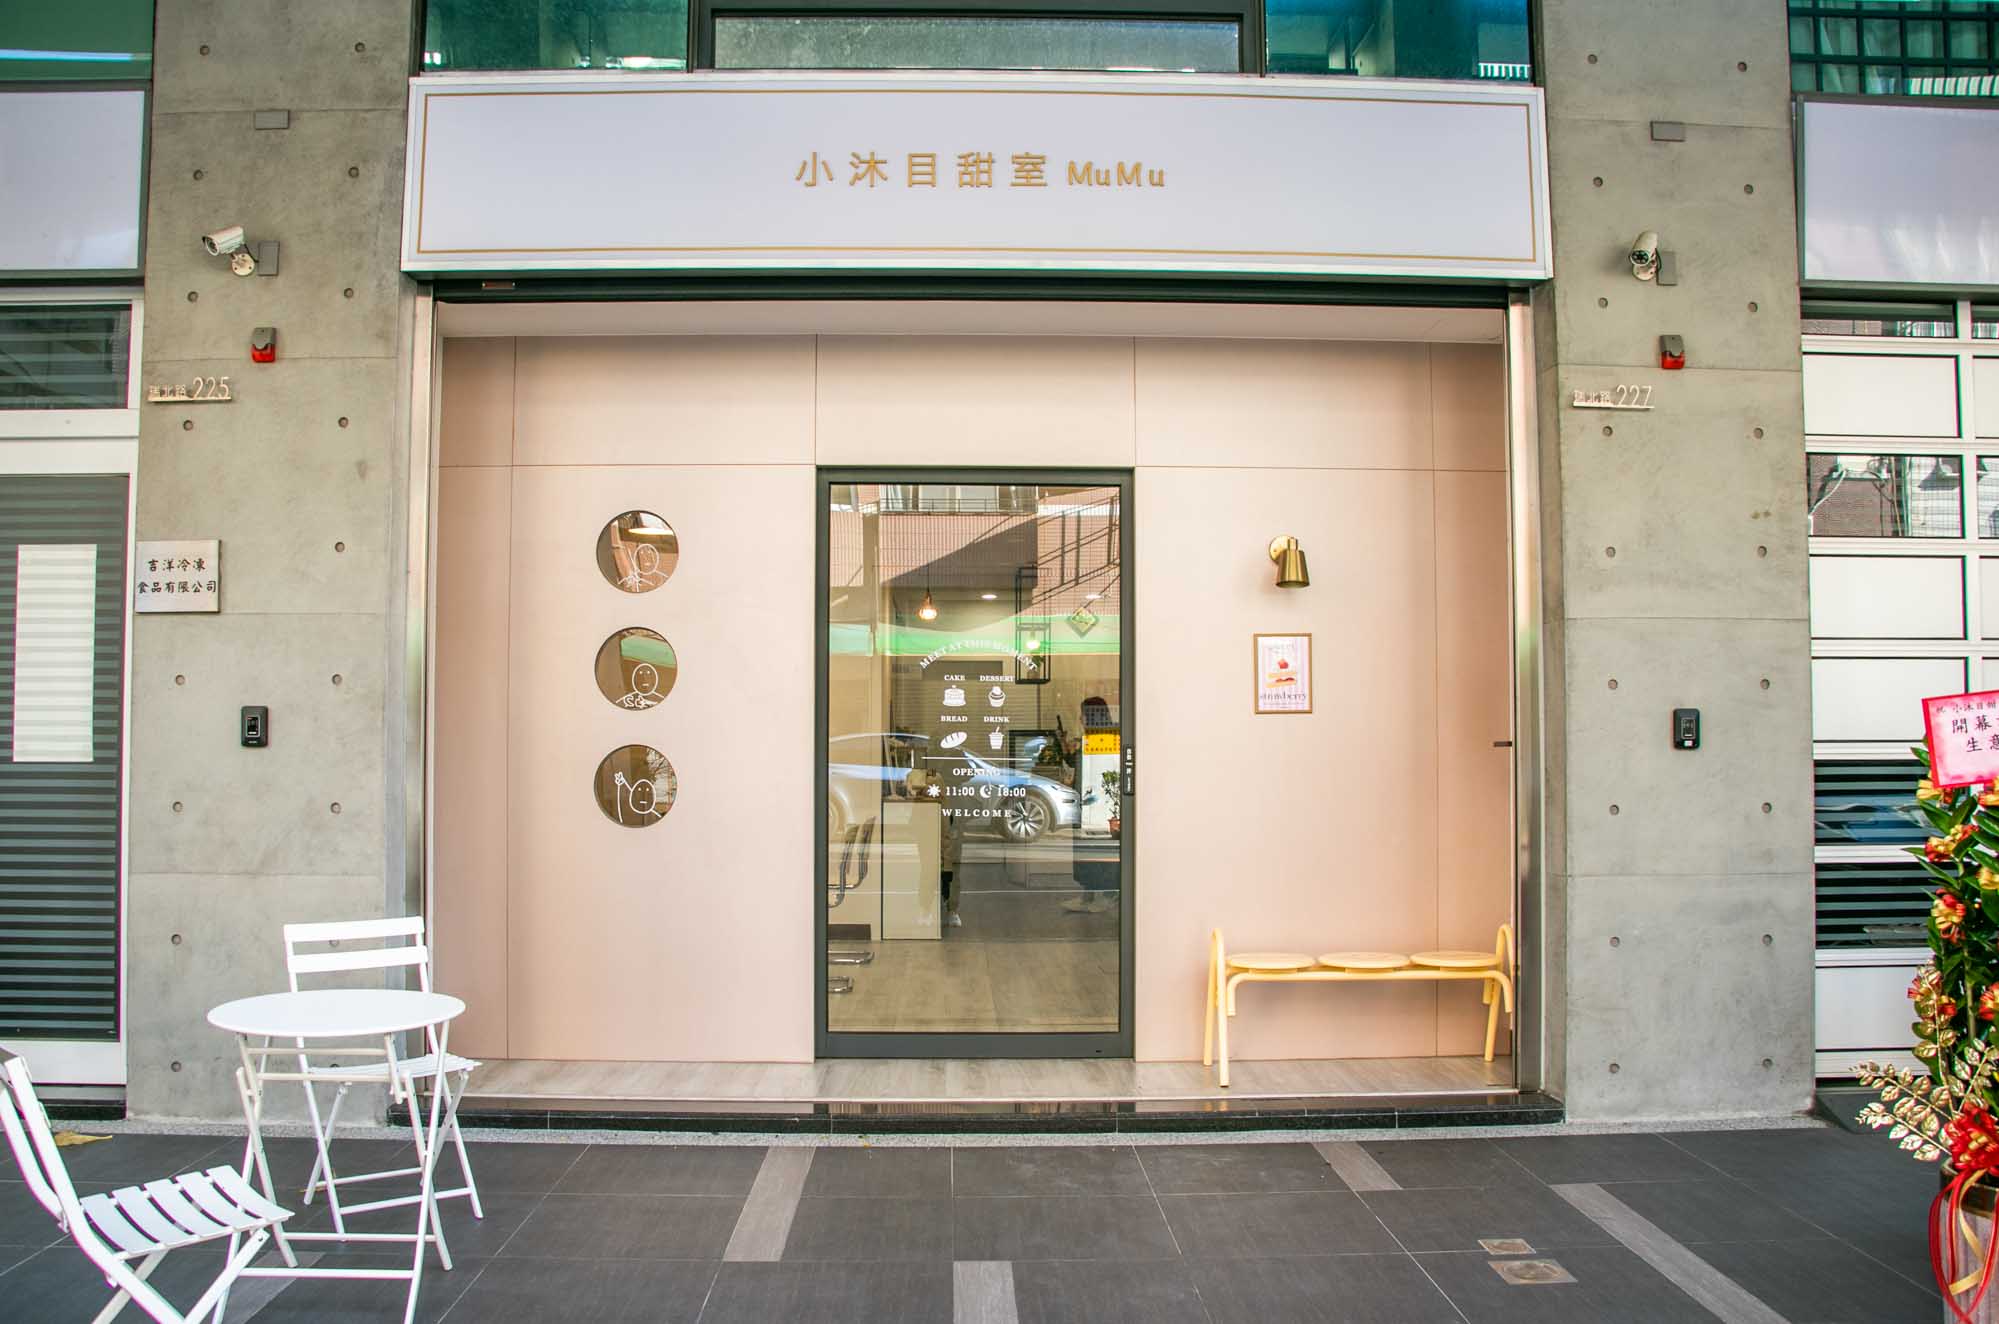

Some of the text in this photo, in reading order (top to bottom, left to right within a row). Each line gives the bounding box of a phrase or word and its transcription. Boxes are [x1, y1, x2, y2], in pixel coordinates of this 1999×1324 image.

[795, 151, 1165, 188] 小沐目甜室 MuMu
[192, 376, 230, 399] 225
[1616, 384, 1652, 406] 227
[137, 580, 217, 594] 食品有限公司
[1952, 715, 1999, 734] 開幕
[953, 768, 1000, 776] OPENING
[946, 786, 1026, 797] 11:00 18:00
[942, 808, 1012, 817] WELCOME
